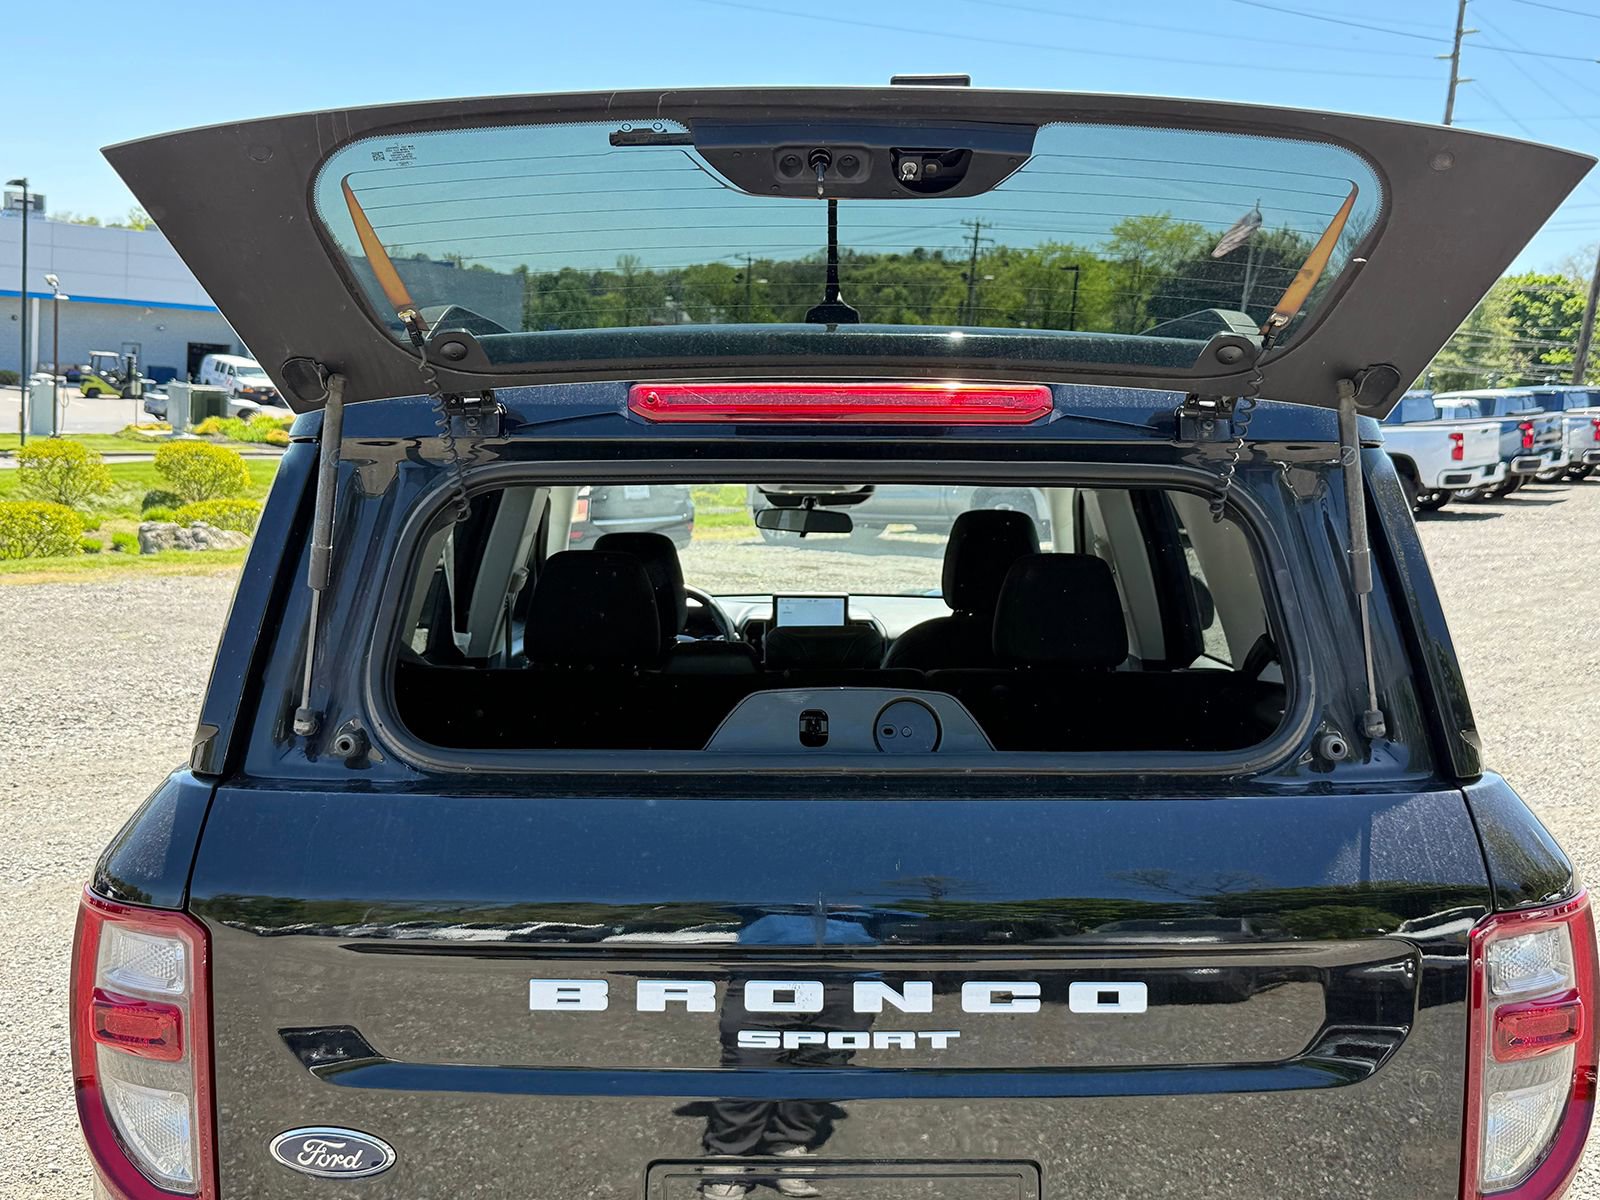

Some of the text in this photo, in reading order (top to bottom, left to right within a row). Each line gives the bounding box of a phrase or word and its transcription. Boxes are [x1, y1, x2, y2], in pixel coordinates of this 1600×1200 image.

[530, 979, 1148, 1013] BRONCO
[737, 1030, 961, 1049] SPORT
[297, 1138, 364, 1169] Ford
